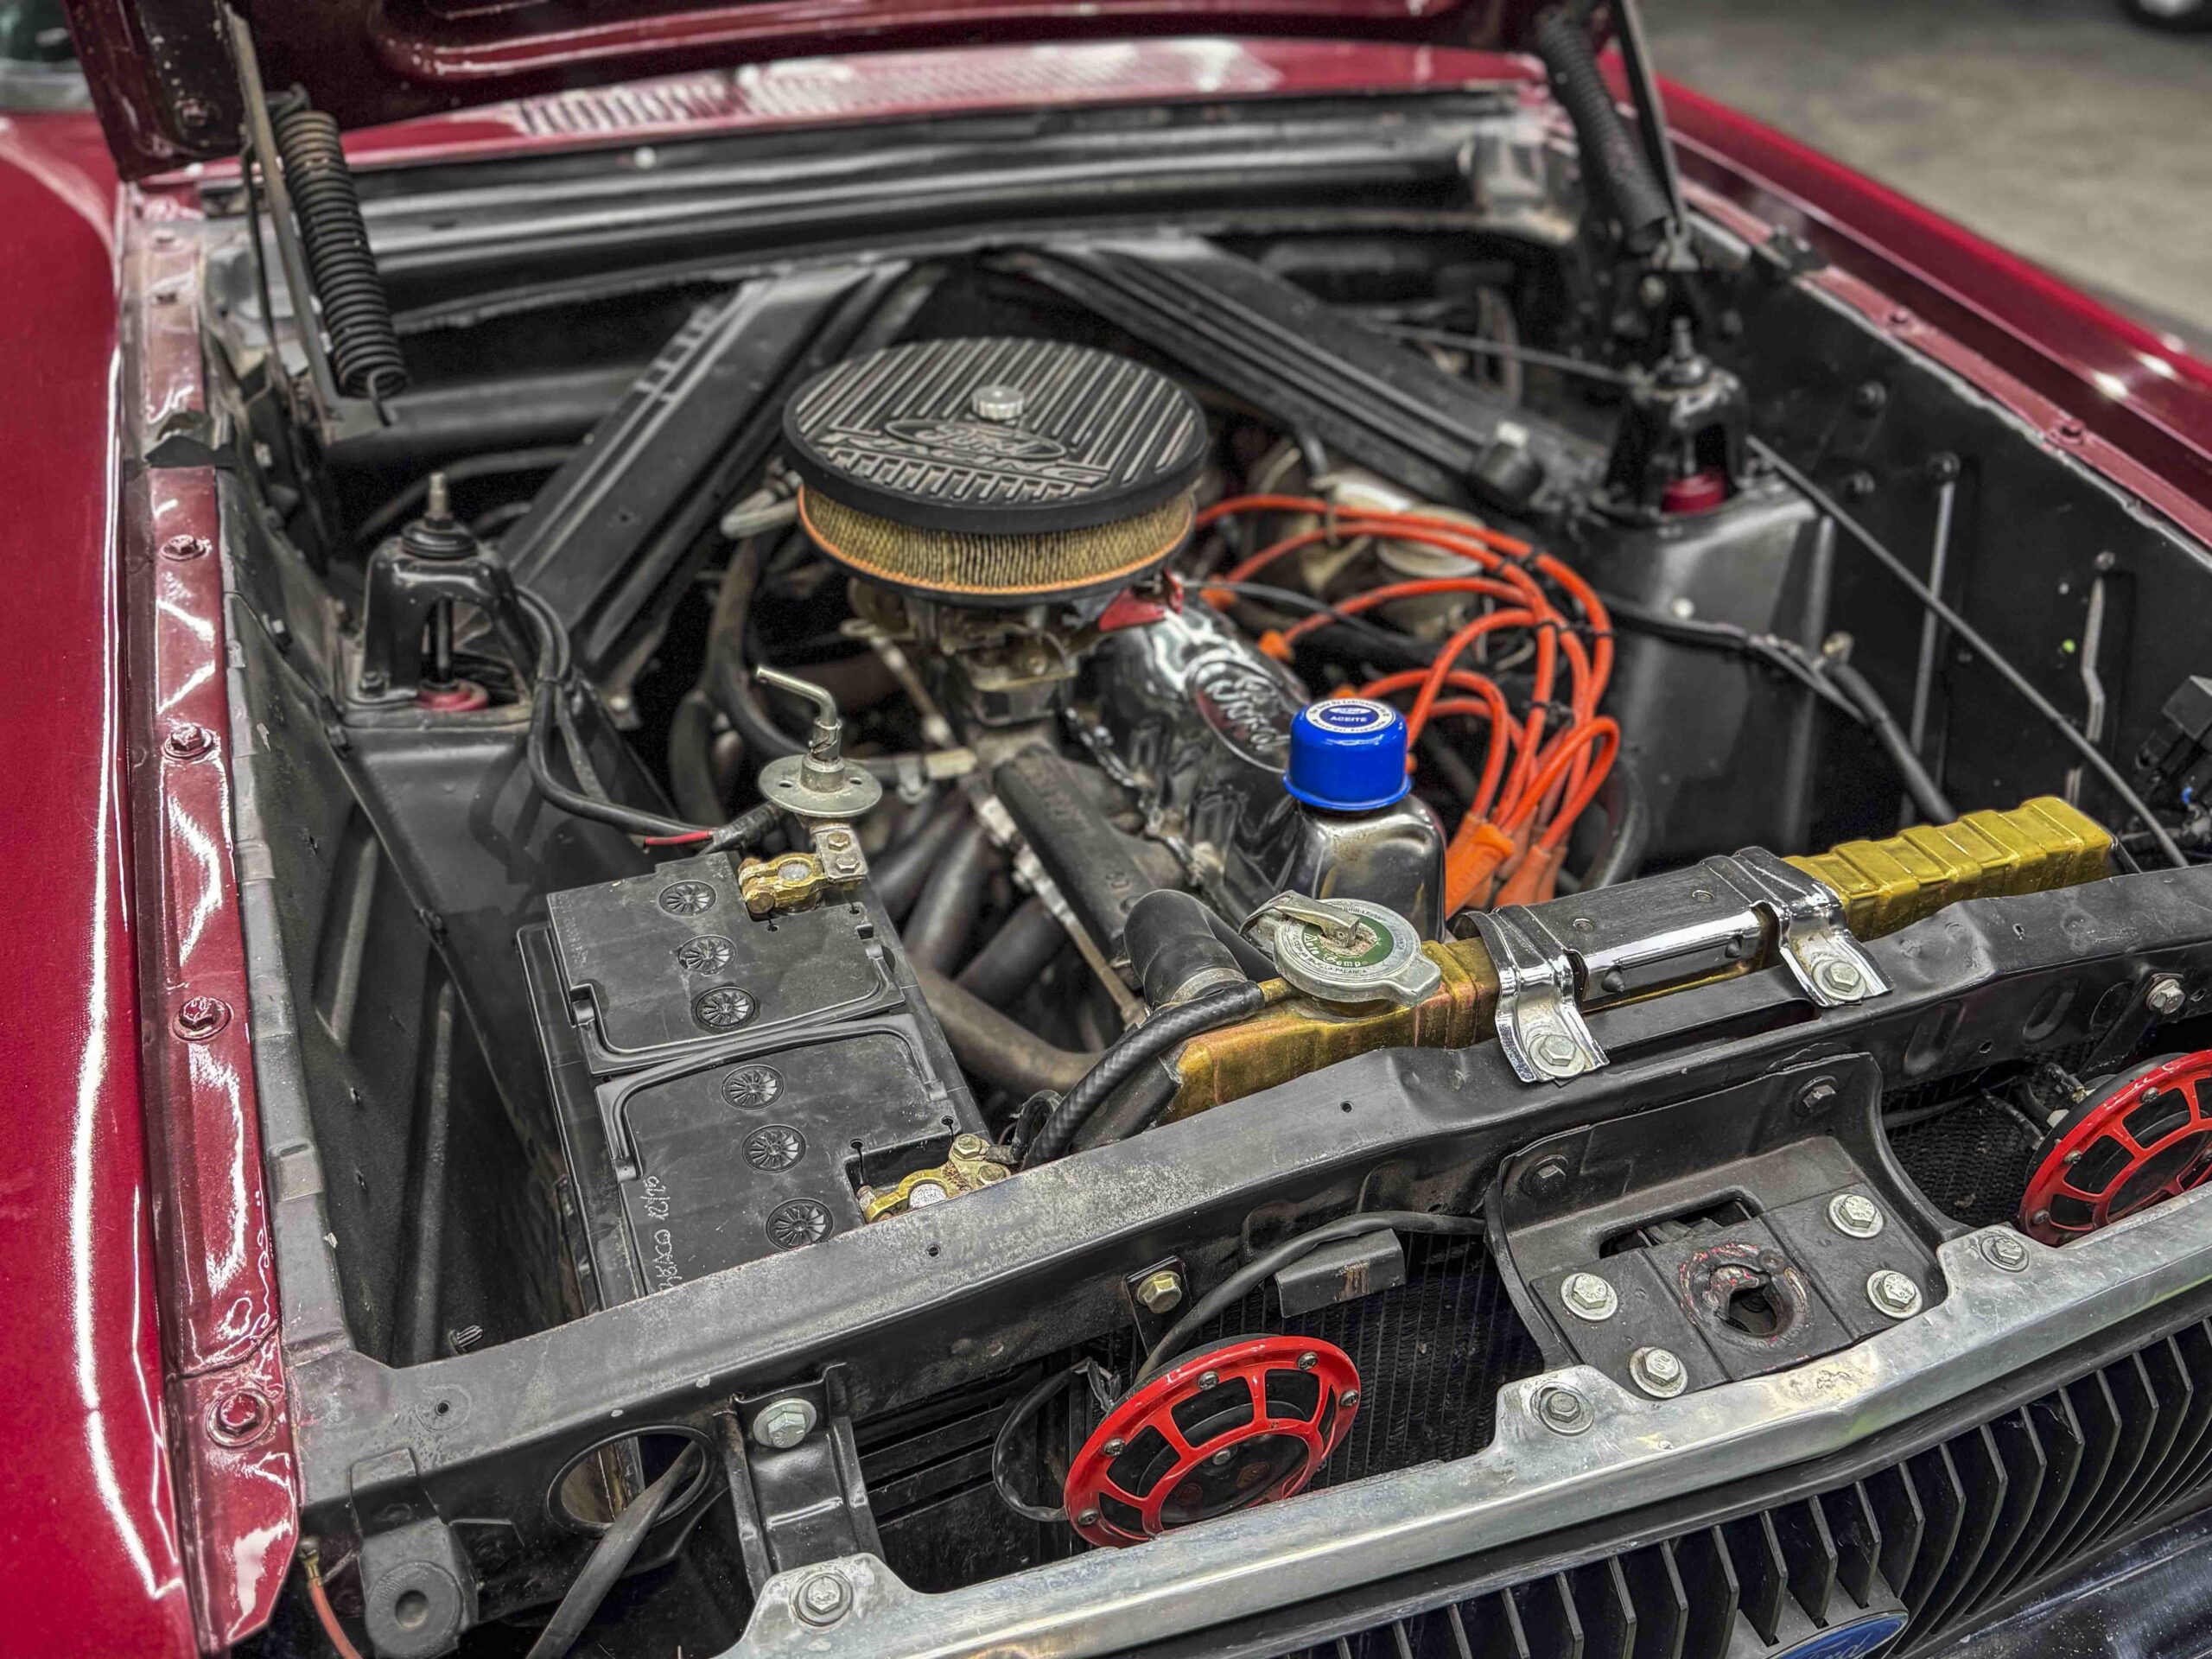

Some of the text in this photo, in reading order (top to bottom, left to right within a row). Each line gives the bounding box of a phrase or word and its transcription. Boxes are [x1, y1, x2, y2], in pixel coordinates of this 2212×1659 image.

[818, 432, 1111, 488] RACING
[913, 423, 1045, 455] Ford
[1204, 677, 1290, 752] Ford
[1334, 966, 1368, 976] PALANCA
